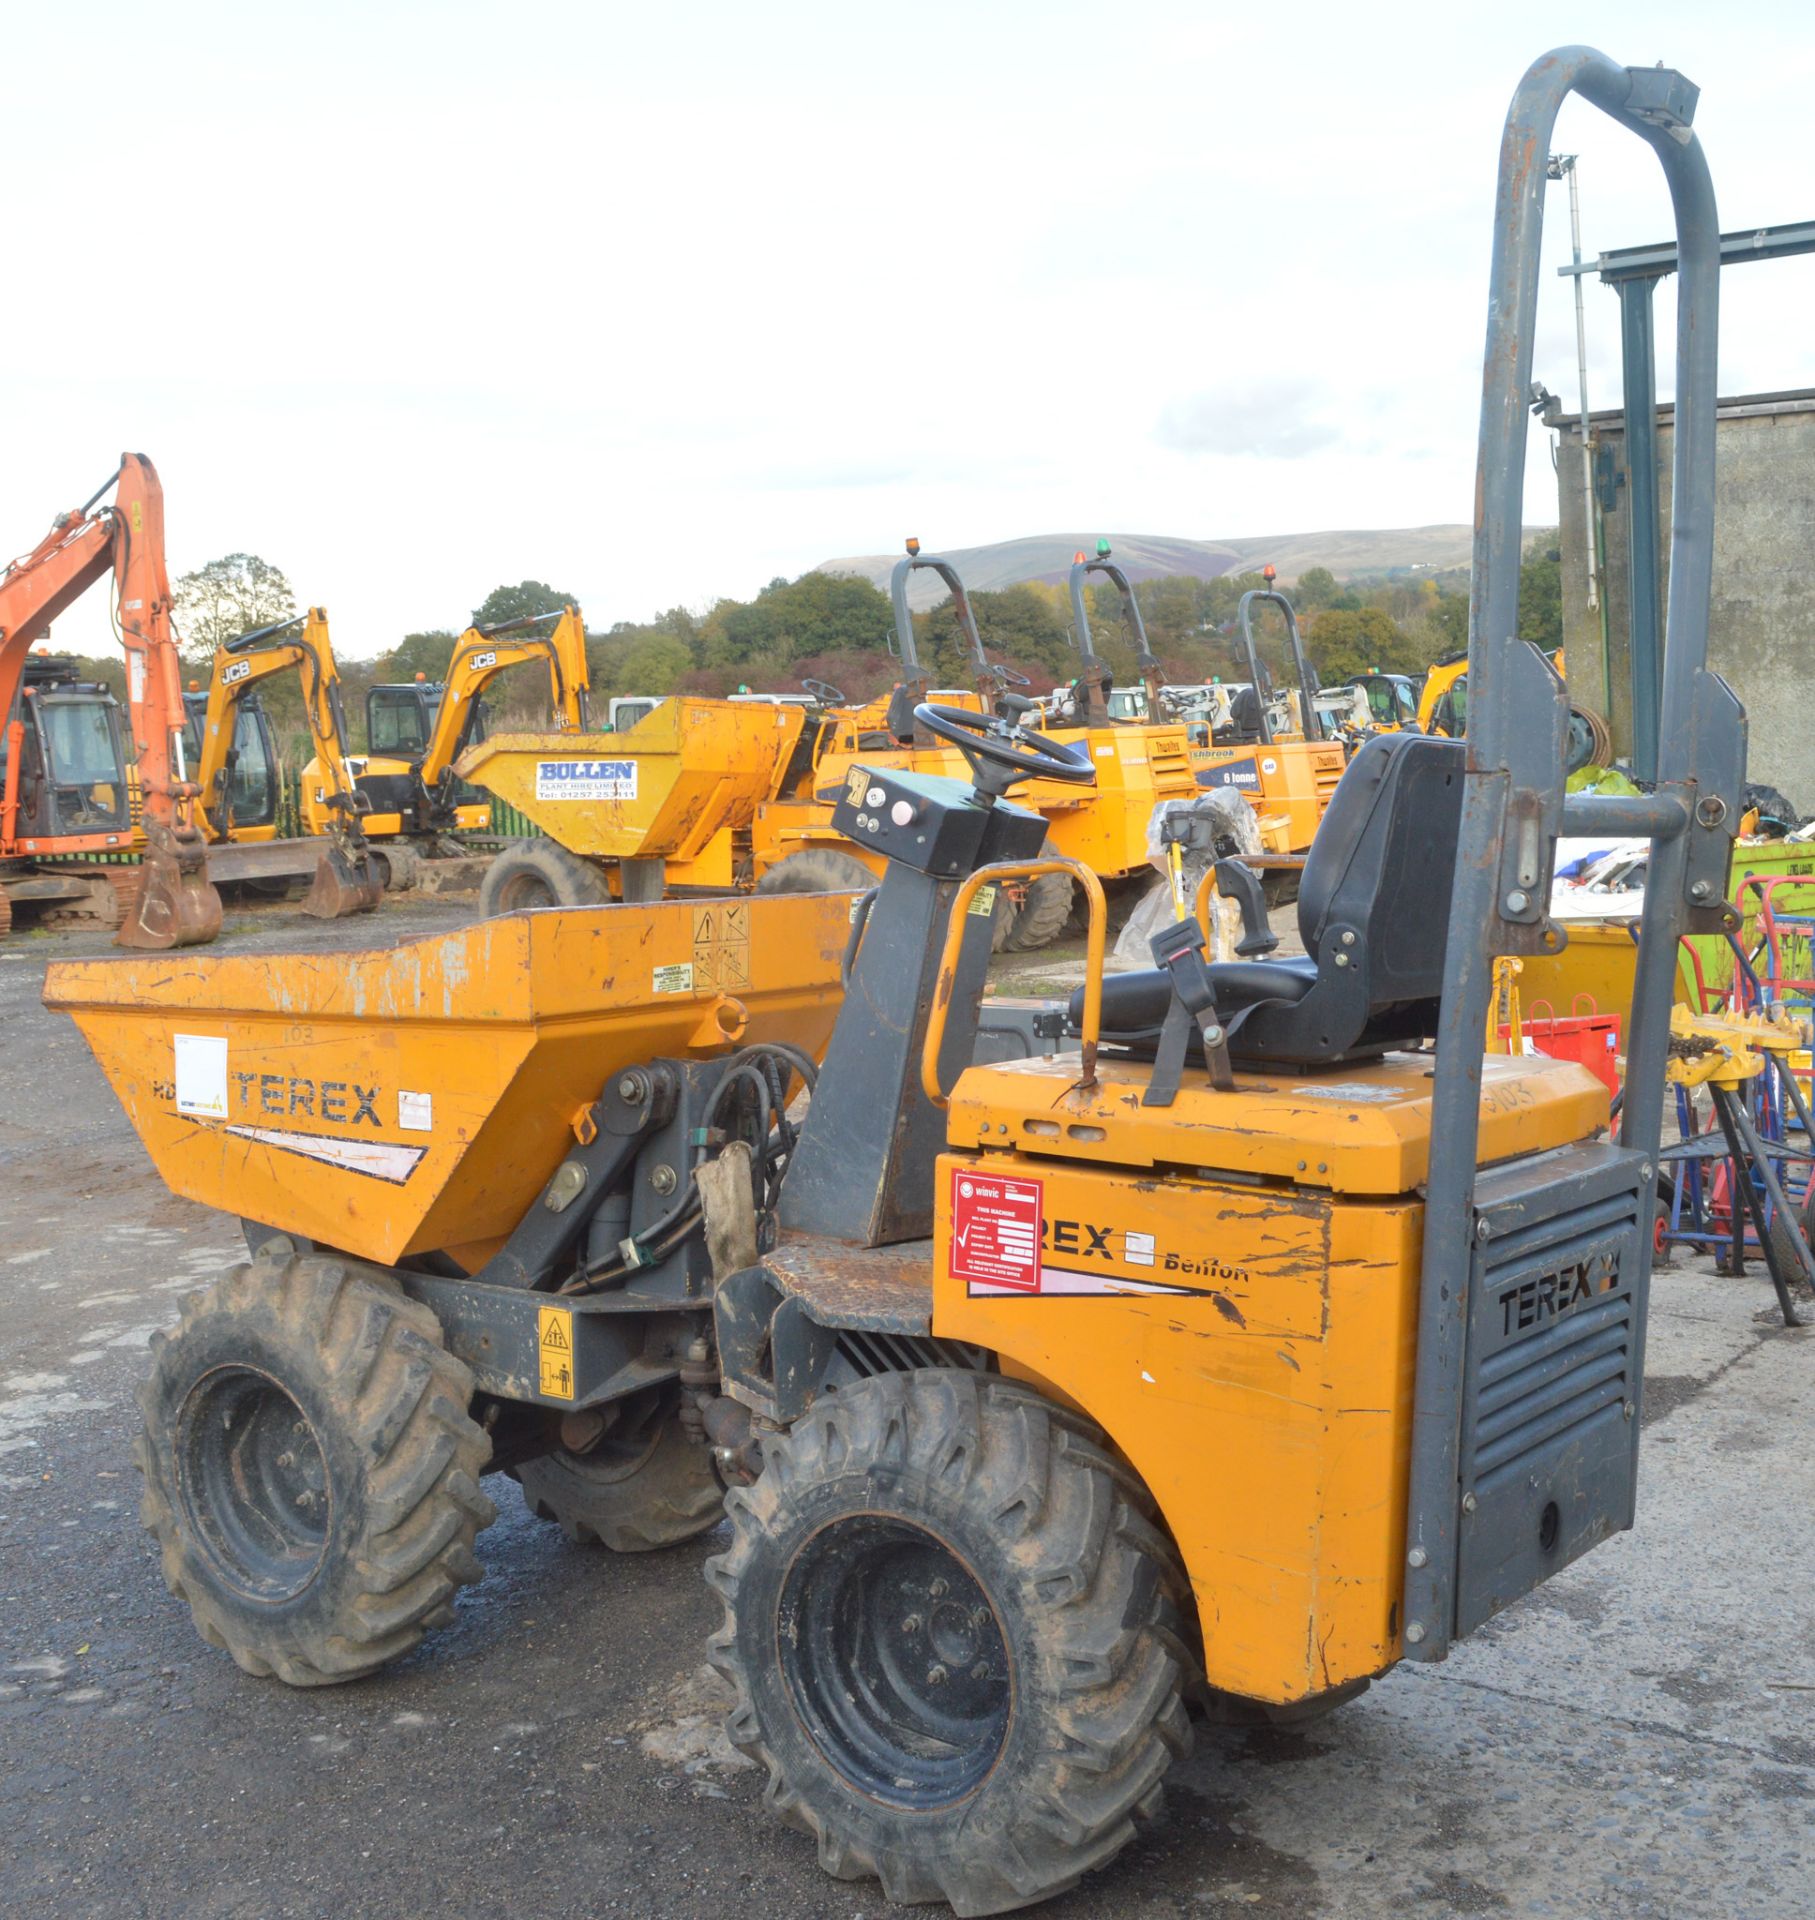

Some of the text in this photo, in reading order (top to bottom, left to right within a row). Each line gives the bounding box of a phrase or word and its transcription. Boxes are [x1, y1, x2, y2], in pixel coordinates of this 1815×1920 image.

[470, 651, 496, 670] JCB
[222, 660, 250, 684] JCB
[1192, 750, 1235, 759] shbrook
[540, 762, 634, 780] BULLEN
[1224, 772, 1257, 784] 6 tonne
[540, 783, 568, 791] PLANT
[571, 782, 593, 790] HIRE
[234, 1071, 382, 1127] TEREX
[975, 1186, 1000, 1198] winvic
[976, 1206, 1016, 1217] THIS MACHINE
[1499, 1256, 1596, 1336] TEREX
